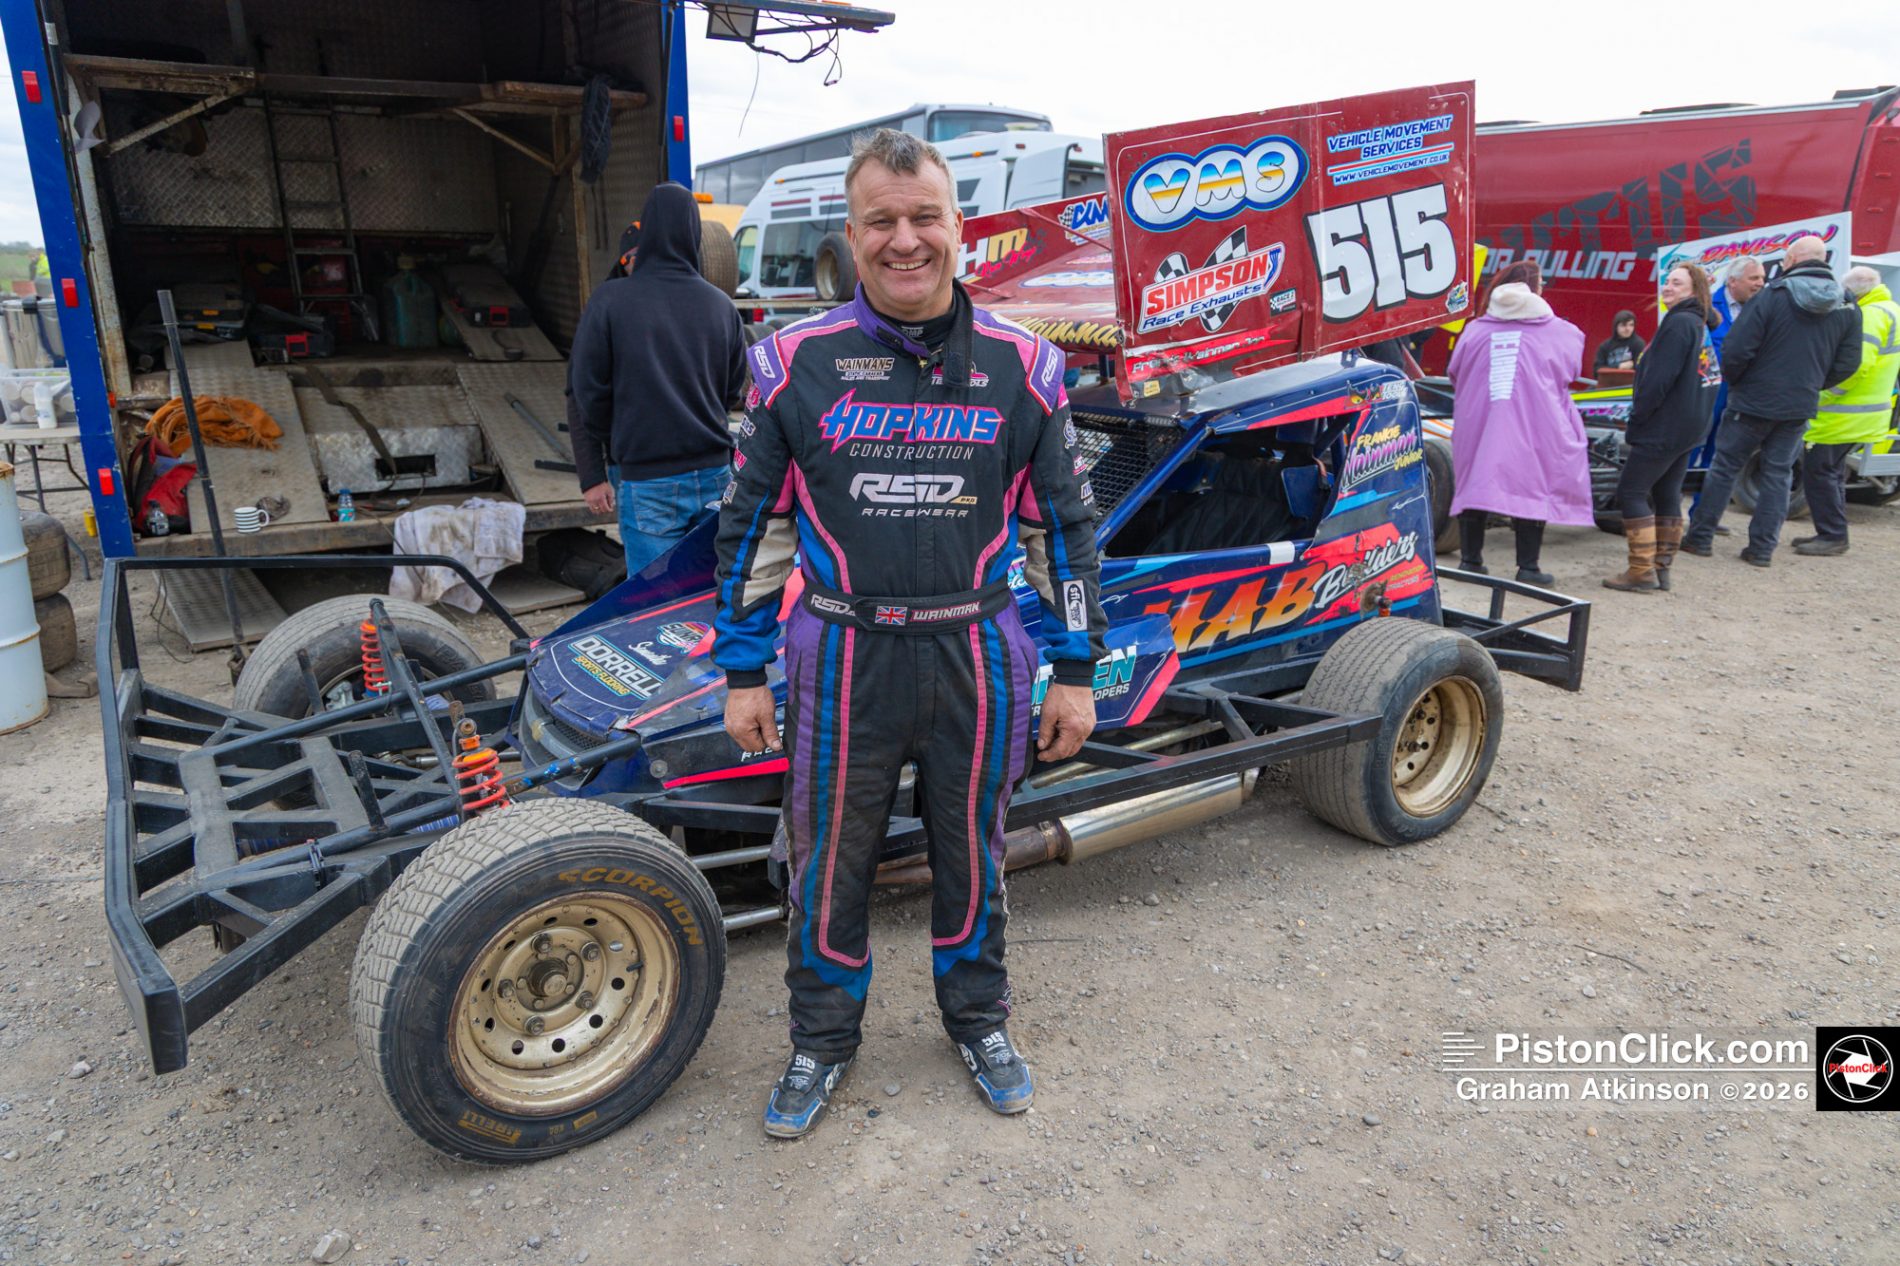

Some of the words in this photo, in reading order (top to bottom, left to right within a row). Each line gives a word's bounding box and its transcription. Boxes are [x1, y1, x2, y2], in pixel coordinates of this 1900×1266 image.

[1329, 130, 1382, 150] VEHICLE
[1385, 117, 1452, 140] MOVEMENT
[1363, 136, 1421, 158] SERVICES
[1143, 150, 1286, 214] VMS
[1304, 183, 1457, 323] 515
[1523, 249, 1637, 281] PULLING
[1145, 249, 1270, 317] SIMPSON
[1142, 310, 1185, 330] Race
[1190, 283, 1263, 314] Exhausts
[754, 345, 776, 379] RSD
[835, 357, 895, 372] WAINMANS
[1041, 347, 1059, 388] RSD
[819, 388, 1006, 453] HOPKINS
[1356, 424, 1401, 449] FRANKIE
[849, 443, 974, 461] CONSTRUCTION
[849, 472, 965, 504] RSD
[862, 508, 969, 518] RACEWEAR
[811, 593, 851, 614] RSD
[912, 601, 981, 622] WAINMAN
[570, 635, 663, 698] DORRELL
[575, 655, 599, 675] SPORTS
[559, 867, 704, 946] SCORPION
[795, 1054, 816, 1071] 515
